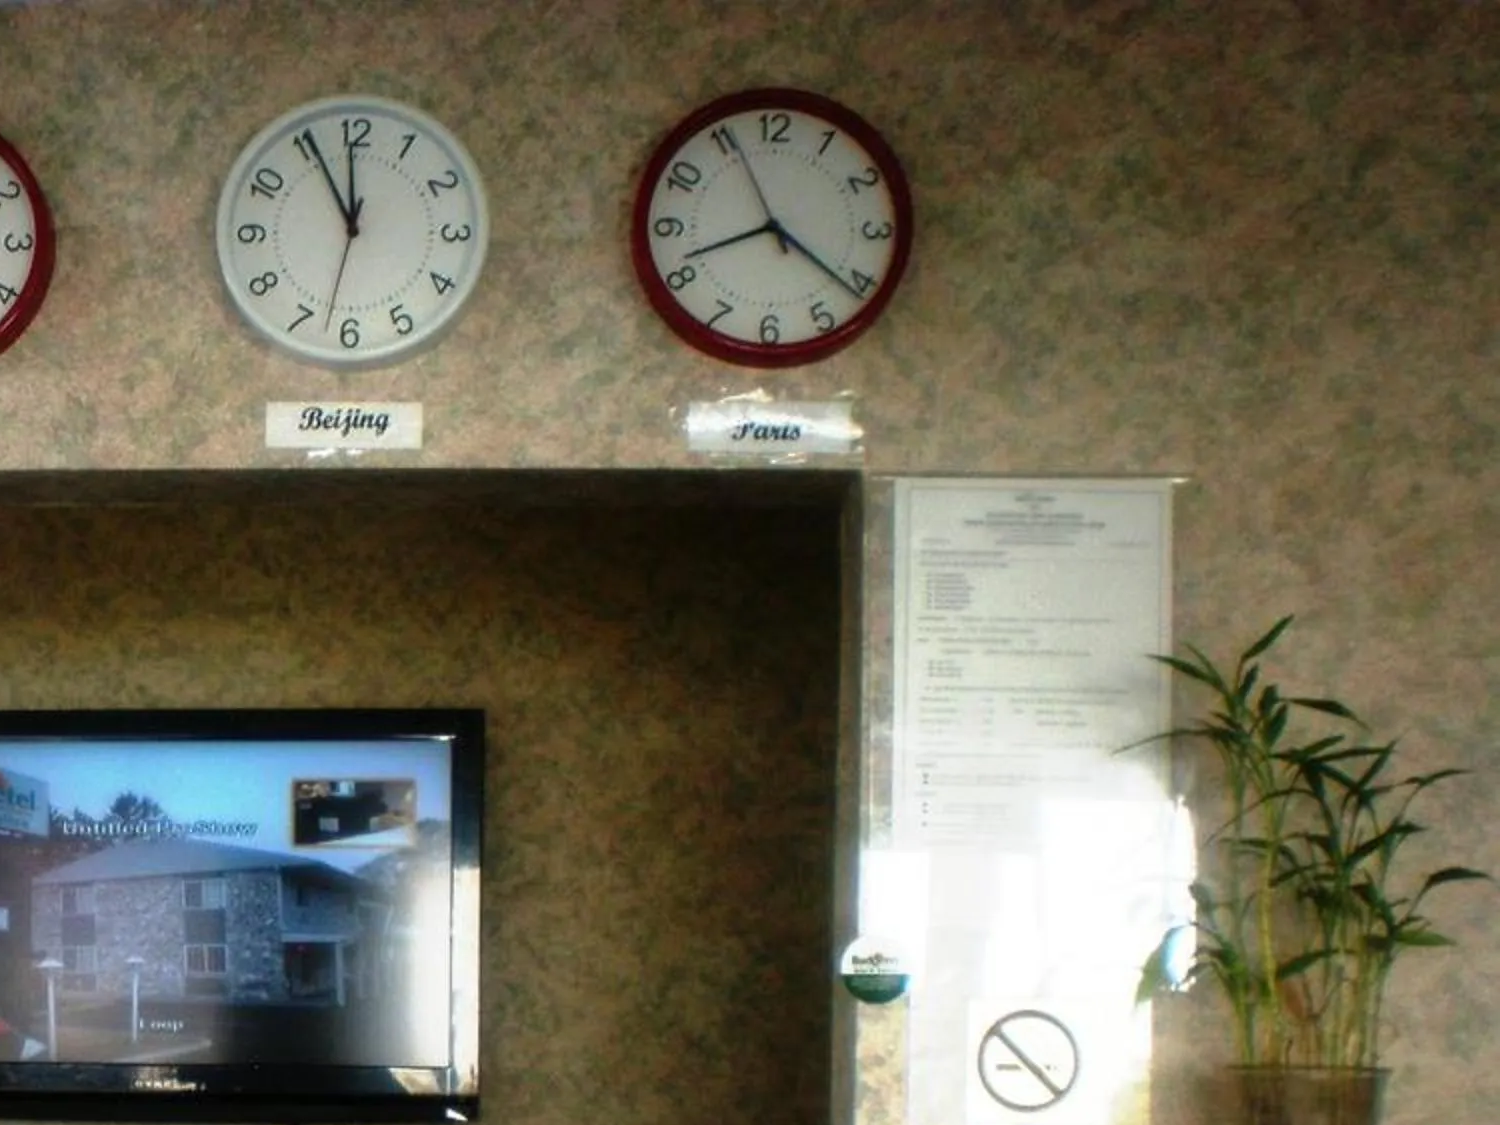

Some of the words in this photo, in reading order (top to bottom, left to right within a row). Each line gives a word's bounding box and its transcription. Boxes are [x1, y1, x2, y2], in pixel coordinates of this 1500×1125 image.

[341, 118, 372, 148] 12
[710, 126, 740, 156] 11
[758, 113, 792, 143] 12
[293, 128, 320, 161] 11
[398, 133, 417, 160] 1
[818, 129, 837, 156] 1
[251, 167, 284, 200] 10
[427, 170, 460, 198] 2
[667, 161, 702, 193] 10
[847, 167, 880, 195] 2
[237, 223, 267, 244] 9
[440, 223, 471, 243] 3
[654, 217, 685, 237] 9
[861, 220, 893, 240] 3
[4, 233, 33, 253] 3
[249, 271, 278, 297] 8
[429, 271, 456, 296] 4
[666, 265, 697, 291] 8
[850, 268, 877, 294] 4
[286, 303, 315, 333] 7
[389, 304, 414, 335] 5
[706, 299, 734, 329] 7
[810, 301, 835, 332] 5
[339, 318, 360, 349] 6
[759, 314, 780, 345] 6
[299, 406, 391, 437] Beijing
[731, 420, 802, 441] Paris
